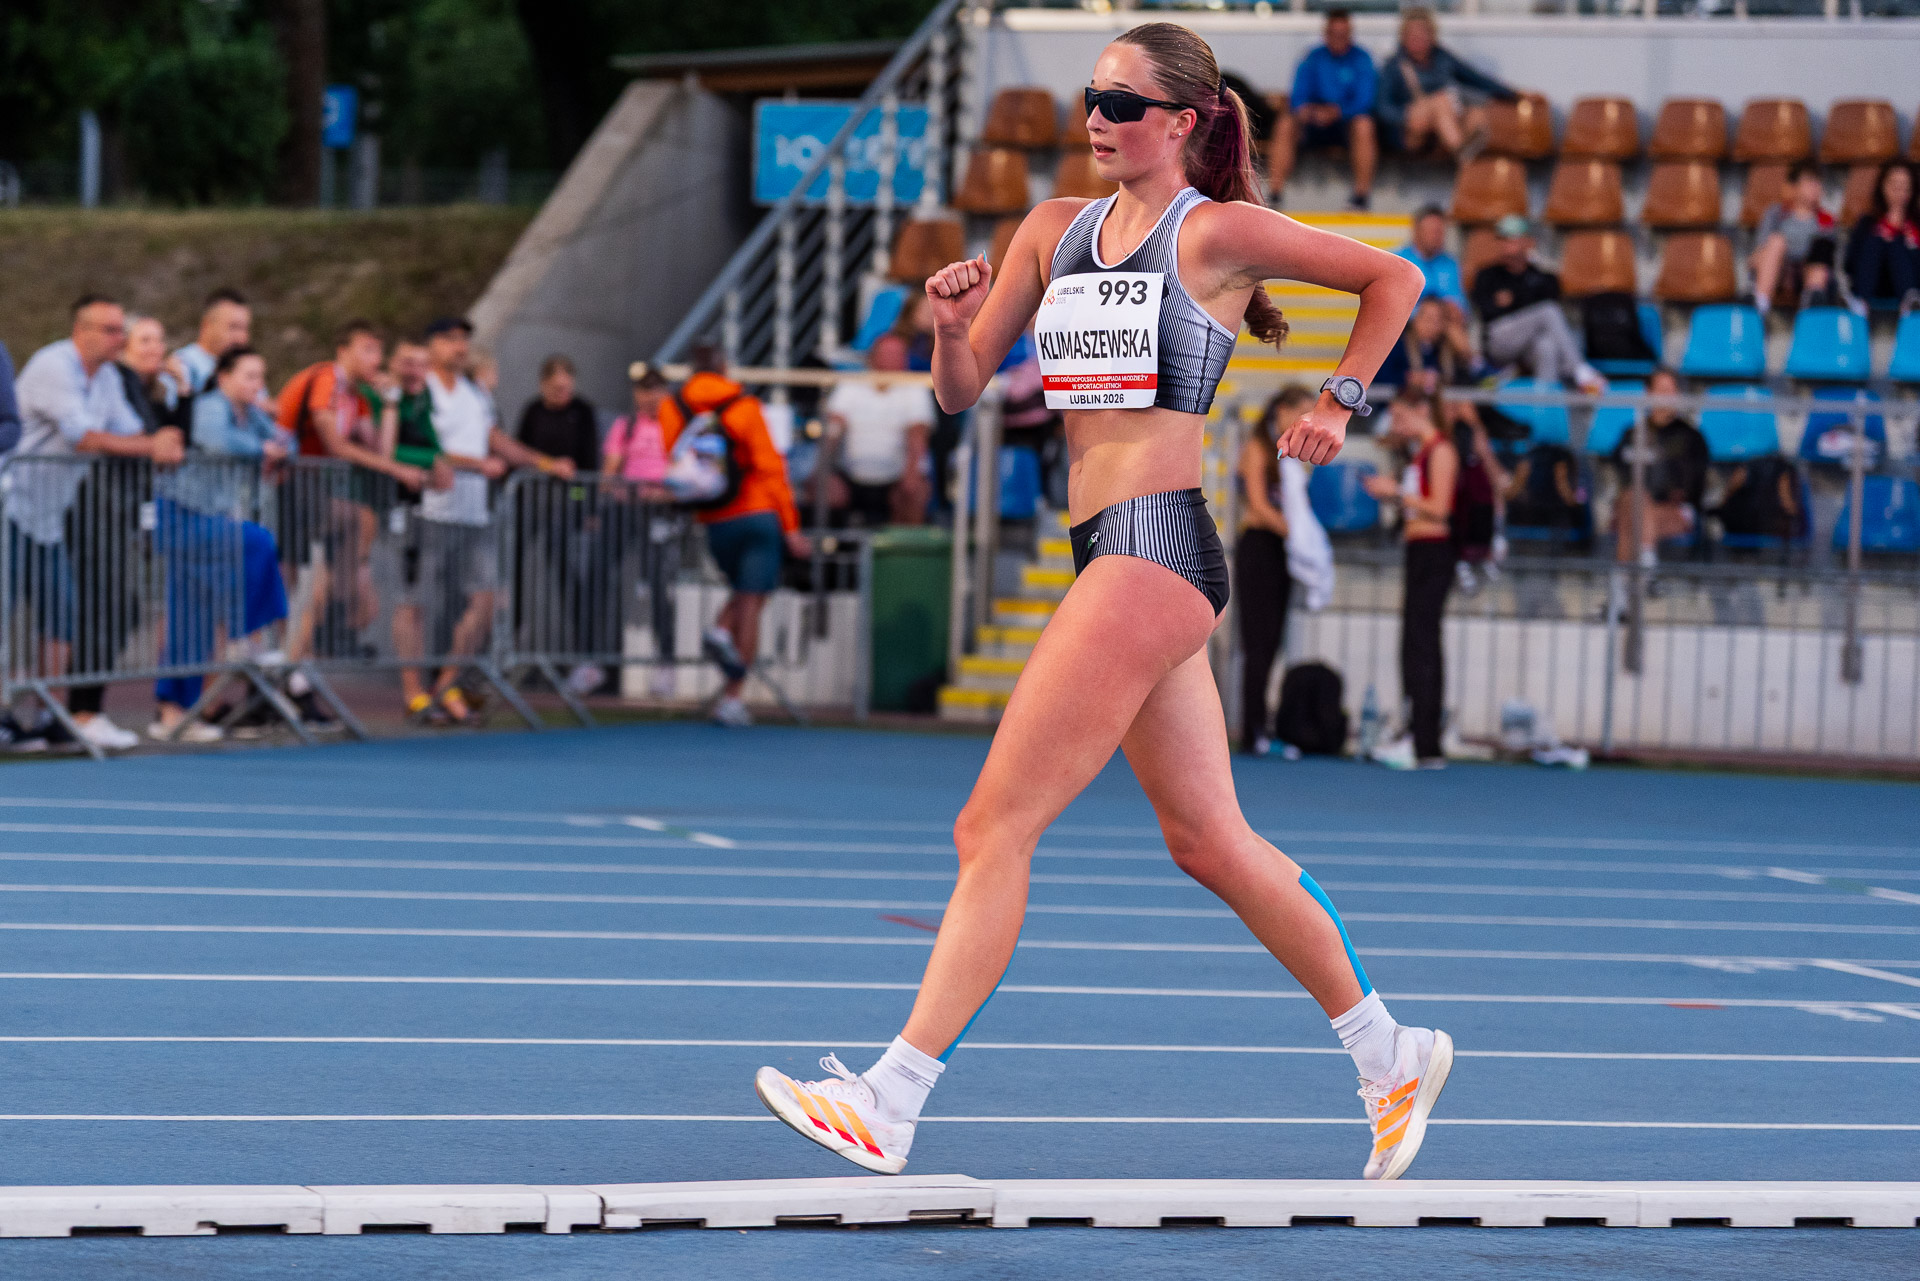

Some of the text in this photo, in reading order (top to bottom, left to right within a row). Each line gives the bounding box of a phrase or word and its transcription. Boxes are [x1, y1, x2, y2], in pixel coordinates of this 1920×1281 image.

[1057, 286, 1085, 296] LUBELSKIE
[1098, 279, 1148, 306] 993
[1038, 328, 1152, 360] KLIMASZEWSKA
[1096, 375, 1121, 383] OLIMPIADA
[1077, 382, 1103, 390] SPORTACH
[1069, 393, 1125, 405] LUBLIN 2026
